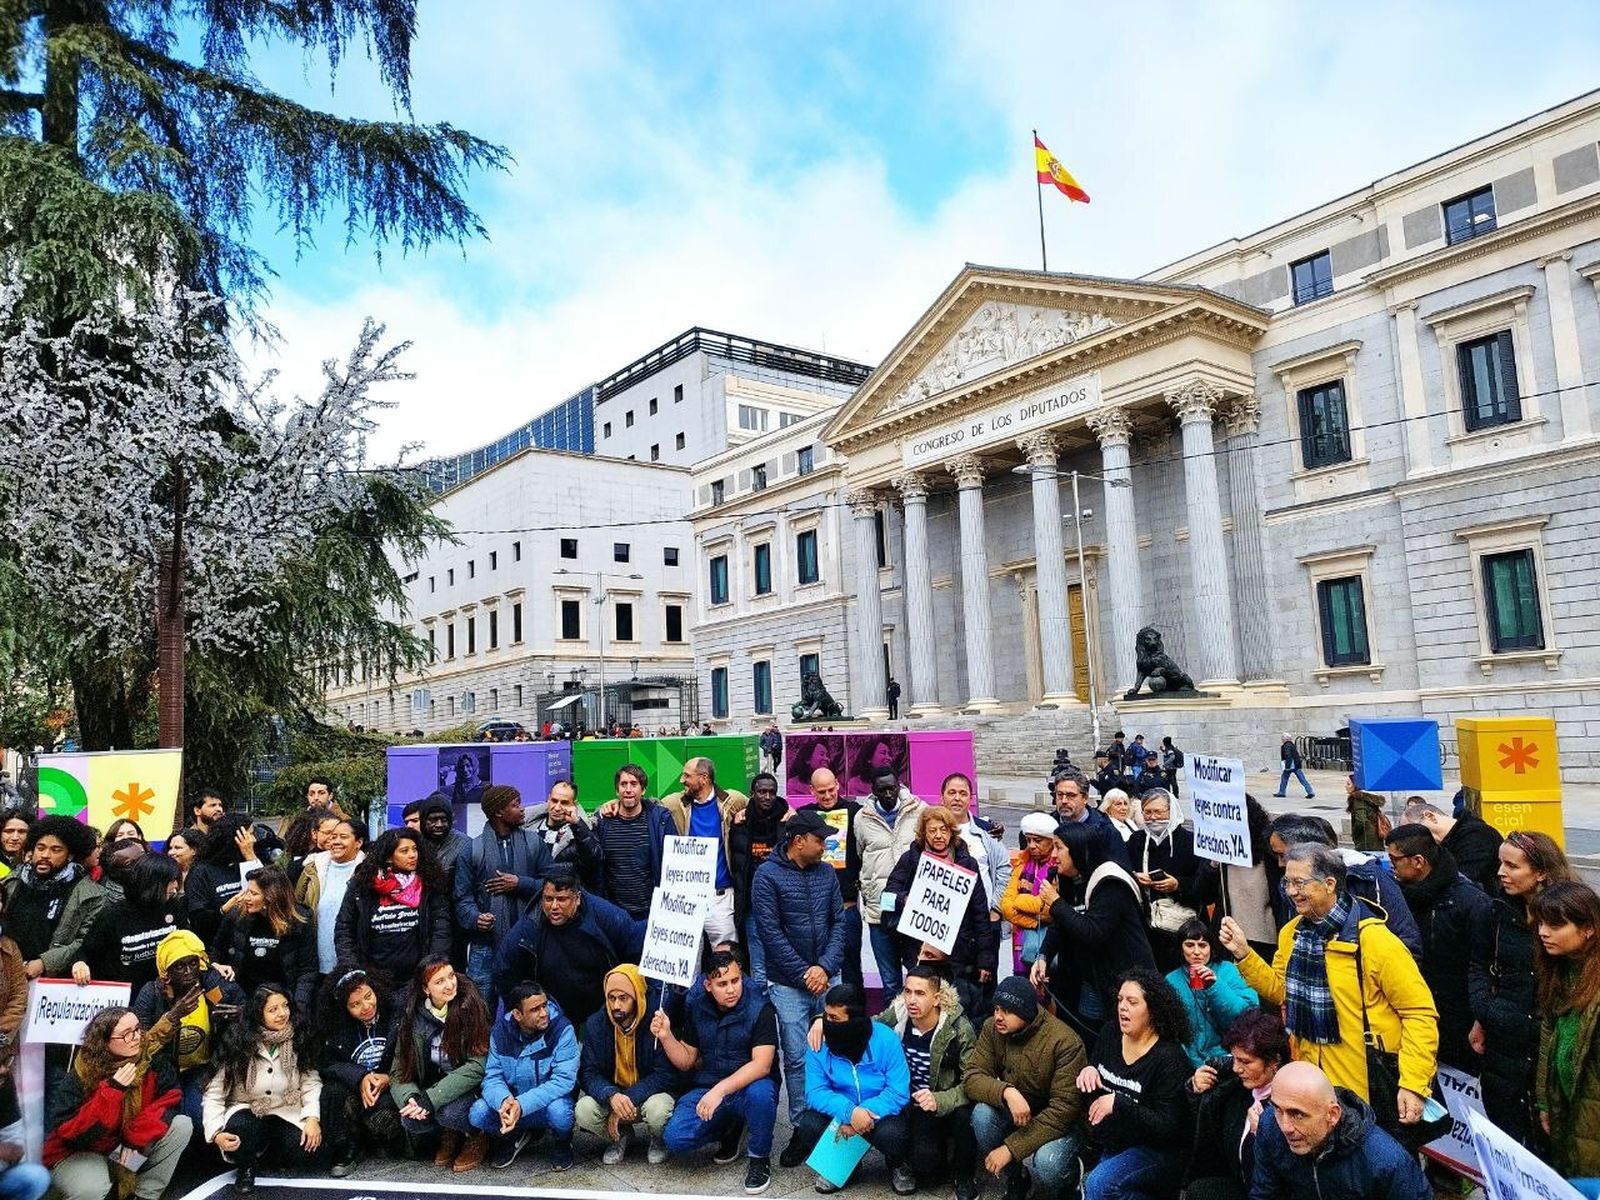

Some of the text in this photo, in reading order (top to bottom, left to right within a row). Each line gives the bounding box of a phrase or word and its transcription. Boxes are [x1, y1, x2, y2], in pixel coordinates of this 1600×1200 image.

[913, 388, 1087, 456] CONGRESO DE LOS DIPUTADOS
[1193, 757, 1232, 783] Modificar
[1193, 792, 1242, 821] leyes contra
[1493, 803, 1532, 813] esen
[1494, 814, 1523, 826] cial
[672, 838, 708, 856] Modificar
[665, 864, 710, 886] leyes contra
[918, 861, 971, 895] ¡PAPELES
[660, 891, 696, 916] Modificar
[921, 887, 951, 915] PARA
[650, 920, 694, 948] leyes contra
[910, 910, 950, 942] TODOS!
